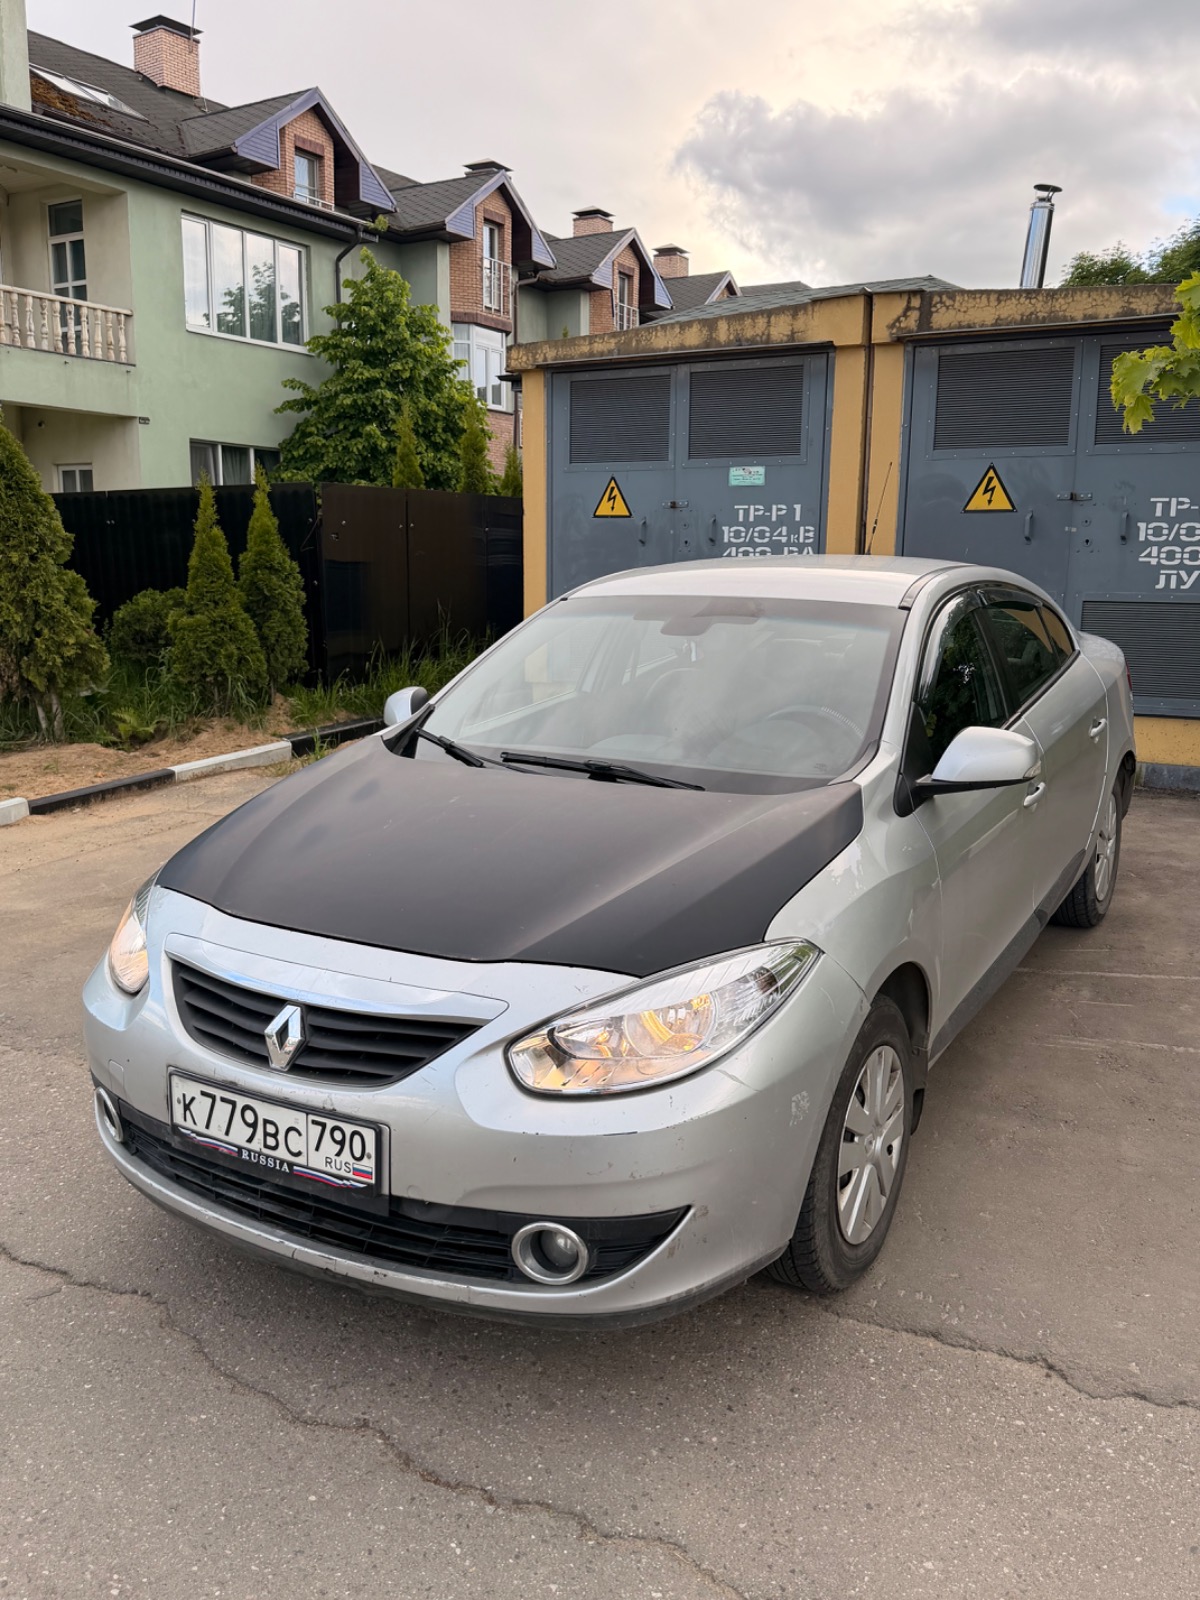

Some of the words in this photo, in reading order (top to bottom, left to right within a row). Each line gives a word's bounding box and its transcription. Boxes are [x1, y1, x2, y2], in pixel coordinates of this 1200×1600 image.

[310, 1119, 366, 1162] 790
[241, 1149, 290, 1173] RUSSIA
[324, 1156, 352, 1174] RUS
